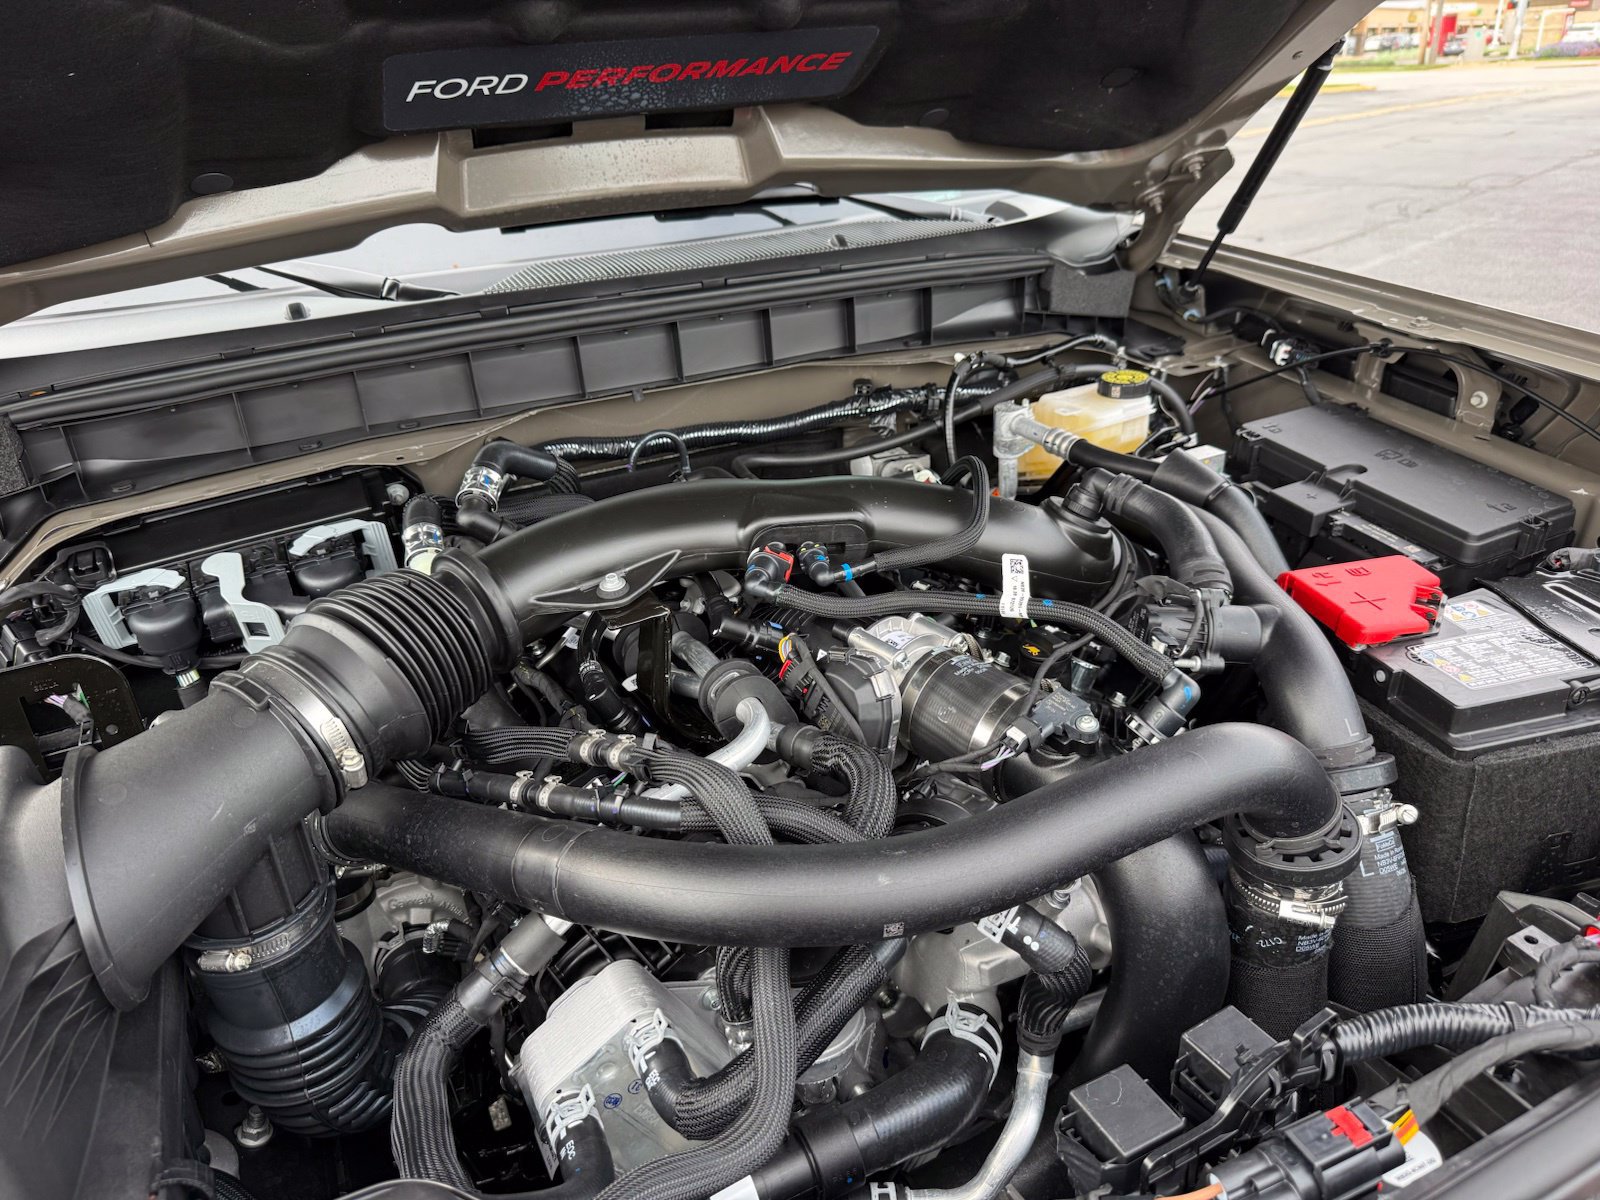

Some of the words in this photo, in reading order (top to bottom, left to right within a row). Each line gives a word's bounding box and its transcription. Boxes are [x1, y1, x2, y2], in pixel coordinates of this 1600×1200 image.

[405, 73, 529, 102] FORD
[534, 51, 853, 92] PERFORMANCE
[1374, 851, 1390, 860] Made
[1360, 860, 1375, 877] L
[389, 893, 433, 909] Garrett
